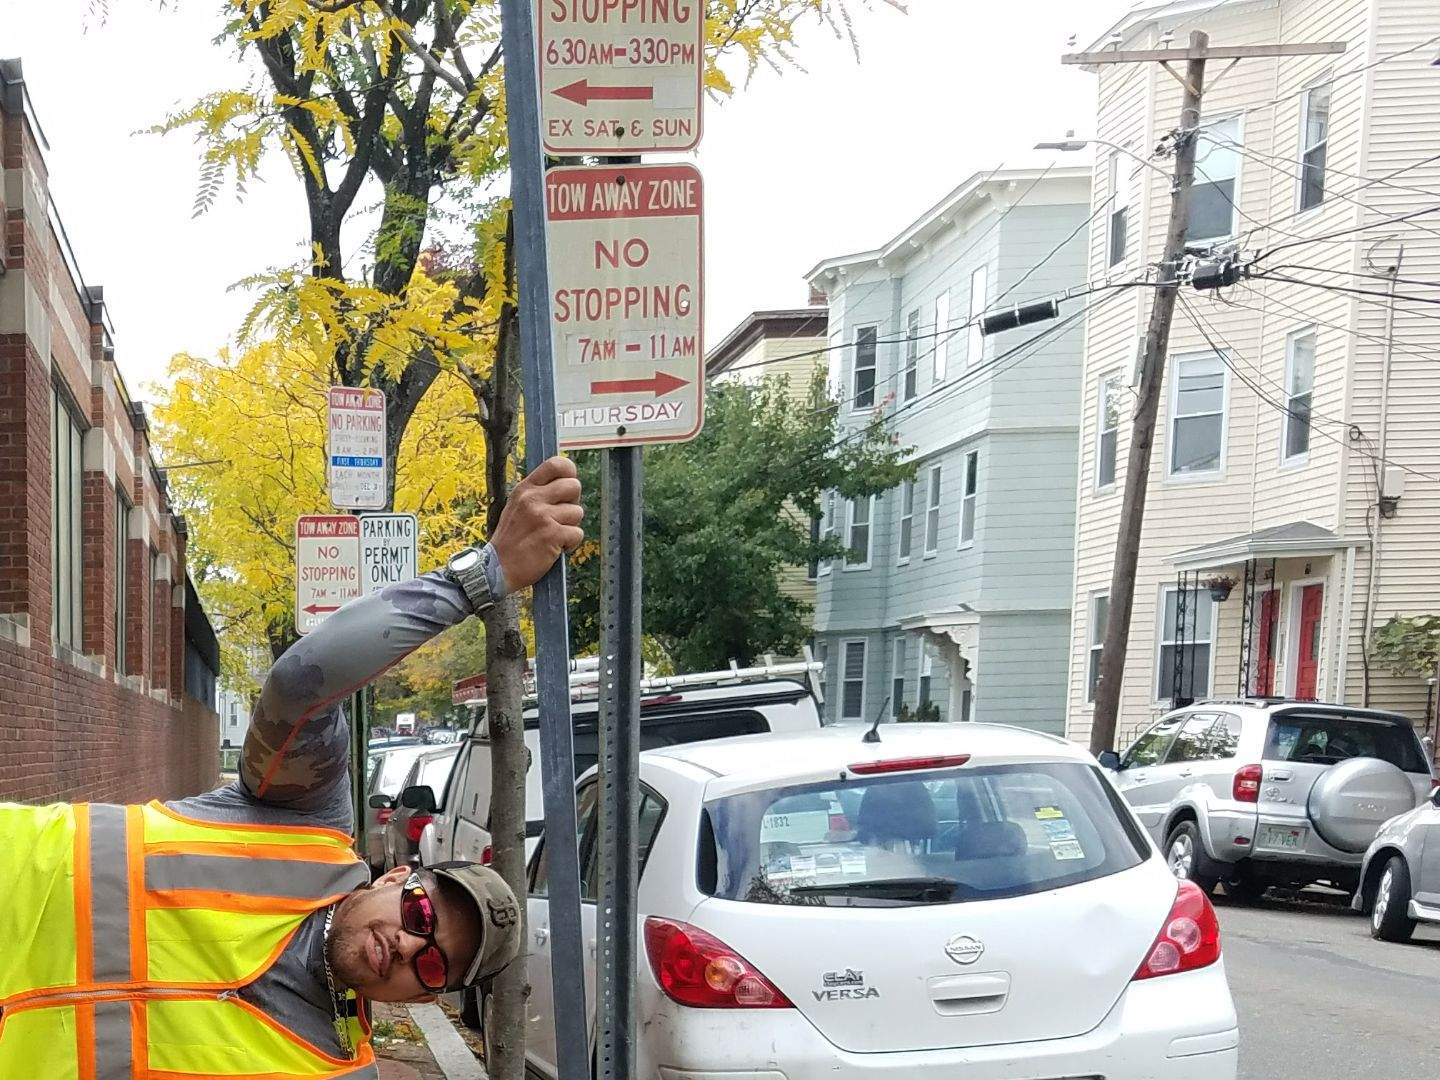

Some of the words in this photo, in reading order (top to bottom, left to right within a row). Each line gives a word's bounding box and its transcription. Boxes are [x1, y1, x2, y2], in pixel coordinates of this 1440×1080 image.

[551, 0, 691, 23] STOPPING
[548, 119, 573, 137] EX
[583, 119, 620, 137] SAT
[631, 119, 644, 137] &
[652, 118, 691, 137] SUN
[547, 182, 587, 214] TOW
[591, 180, 643, 212] AWAY
[648, 179, 697, 210] ZONE
[595, 238, 649, 269] NO
[554, 284, 691, 323] STOPPING
[578, 338, 616, 363] 7AM
[331, 413, 342, 430] NO
[346, 414, 382, 432] PARKING
[559, 401, 683, 426] THURSDAY
[300, 521, 315, 535] TOW
[317, 521, 337, 535] AWAY
[338, 521, 358, 535] ZONE
[363, 519, 411, 538] PARKING
[317, 546, 340, 559] NO
[365, 547, 410, 564] PERMIT
[301, 566, 356, 581] STOPPING
[371, 564, 404, 582] ONLY
[812, 987, 880, 1002] VERSA
